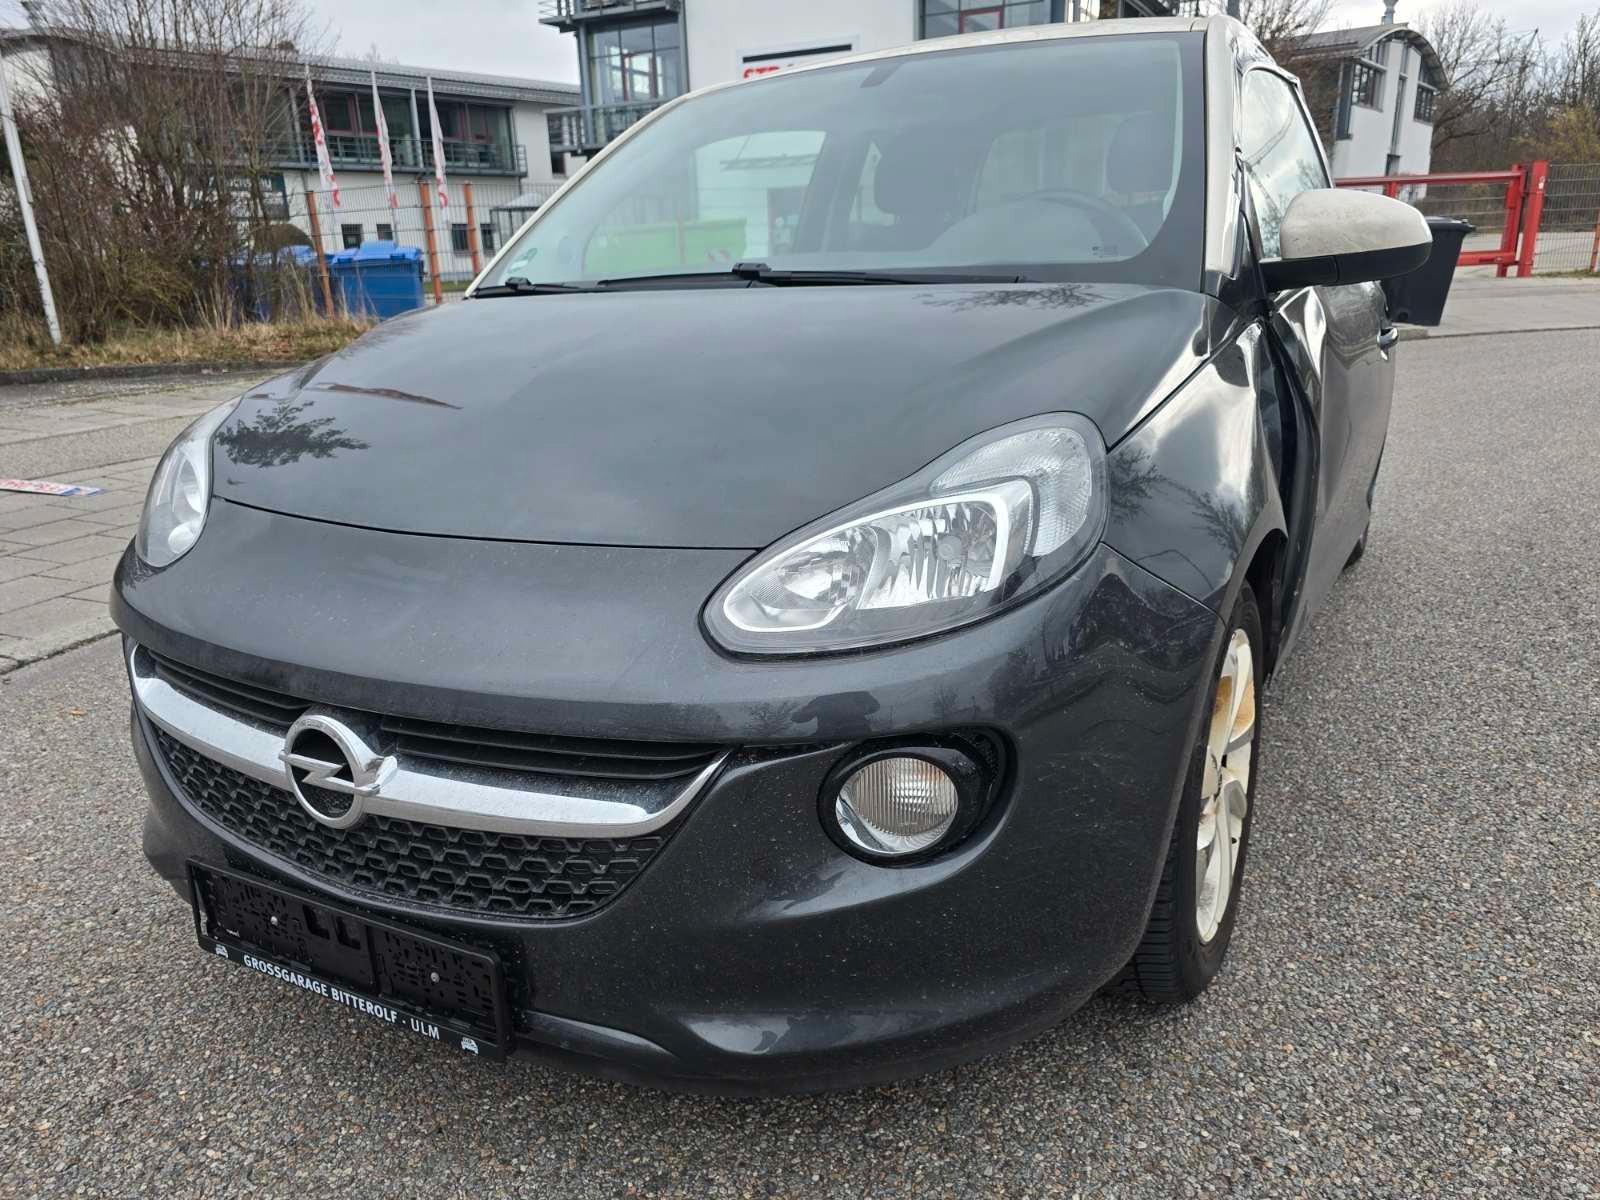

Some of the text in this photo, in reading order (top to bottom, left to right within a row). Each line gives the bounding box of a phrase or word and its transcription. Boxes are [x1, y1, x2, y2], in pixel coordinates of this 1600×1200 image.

[243, 954, 328, 997] GROSSGARAGE
[331, 988, 398, 1024] BITTEROLF
[410, 1018, 440, 1040] ULM
